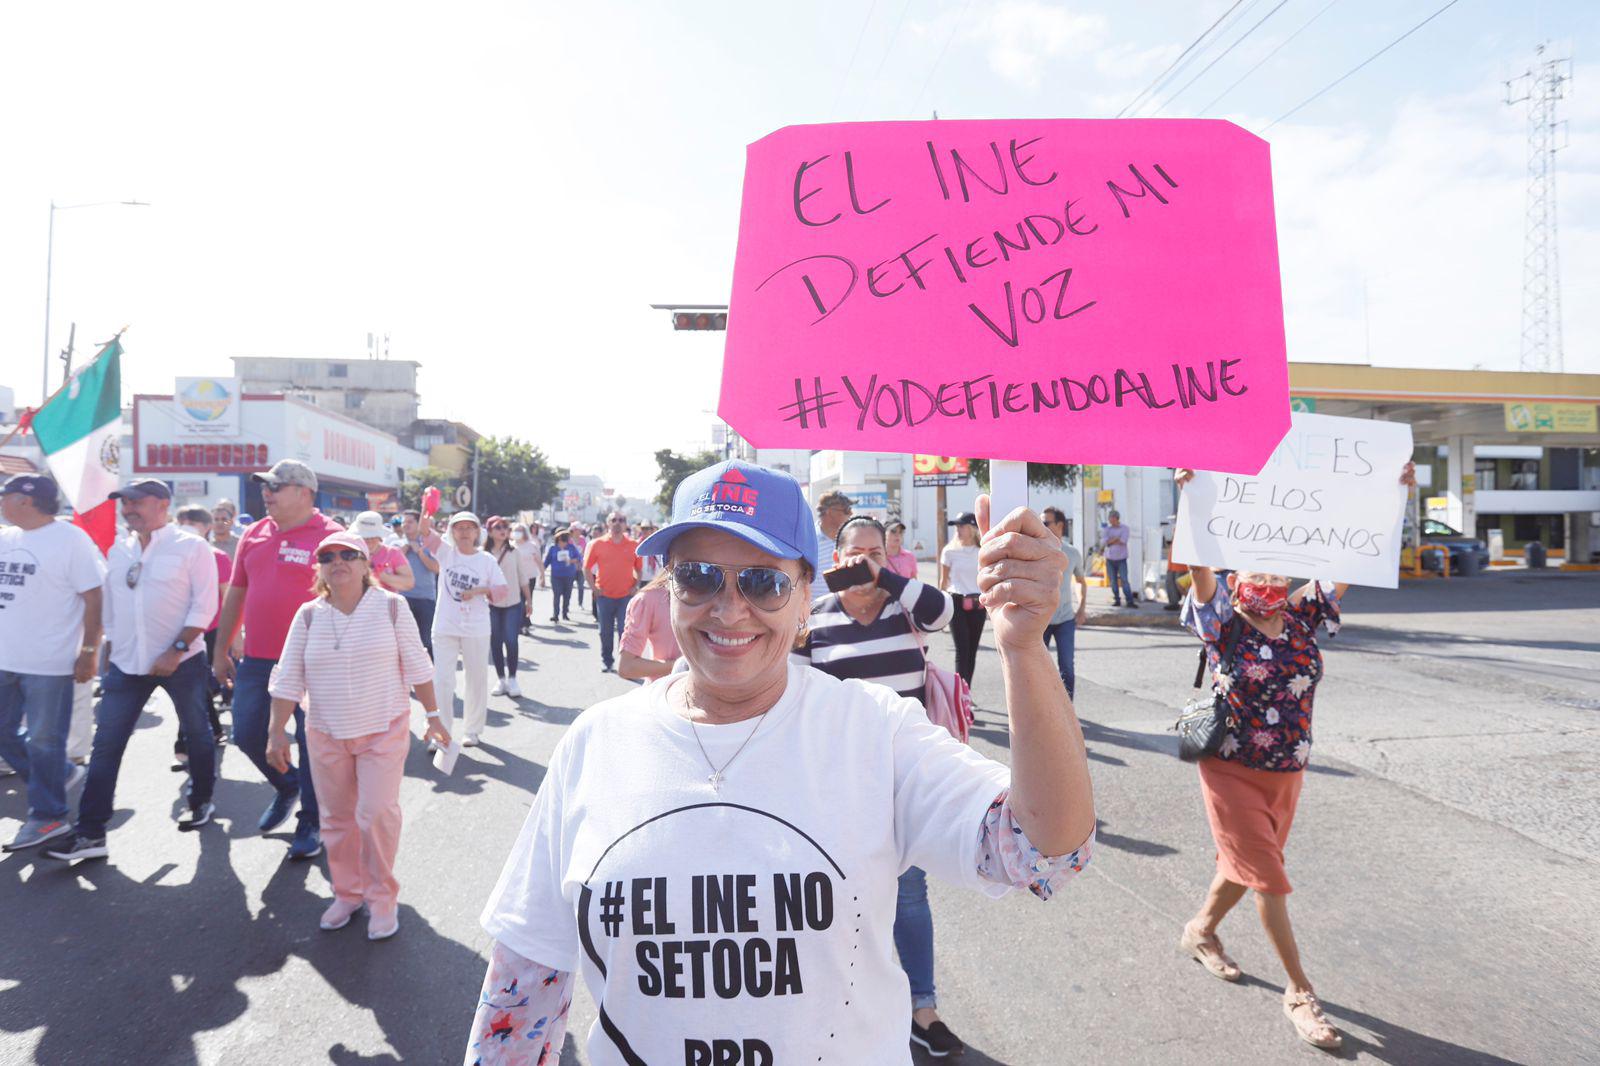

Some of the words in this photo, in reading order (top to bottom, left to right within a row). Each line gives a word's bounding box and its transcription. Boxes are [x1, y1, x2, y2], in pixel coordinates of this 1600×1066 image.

[793, 151, 890, 227] EL
[926, 136, 1059, 203] INE
[754, 198, 1099, 326] DEFIENDE
[1106, 163, 1179, 219] MI
[968, 268, 1098, 348] VOZ
[778, 358, 1249, 432] #YODEFIENDOALINE
[1332, 437, 1374, 477] ES
[711, 483, 758, 506] INE
[1218, 476, 1259, 504] DE
[1269, 484, 1324, 512] LOS
[1206, 515, 1384, 557] CIUDADANOS
[691, 874, 759, 934] INE
[773, 871, 834, 931] NO
[635, 937, 804, 1000] SETOCA
